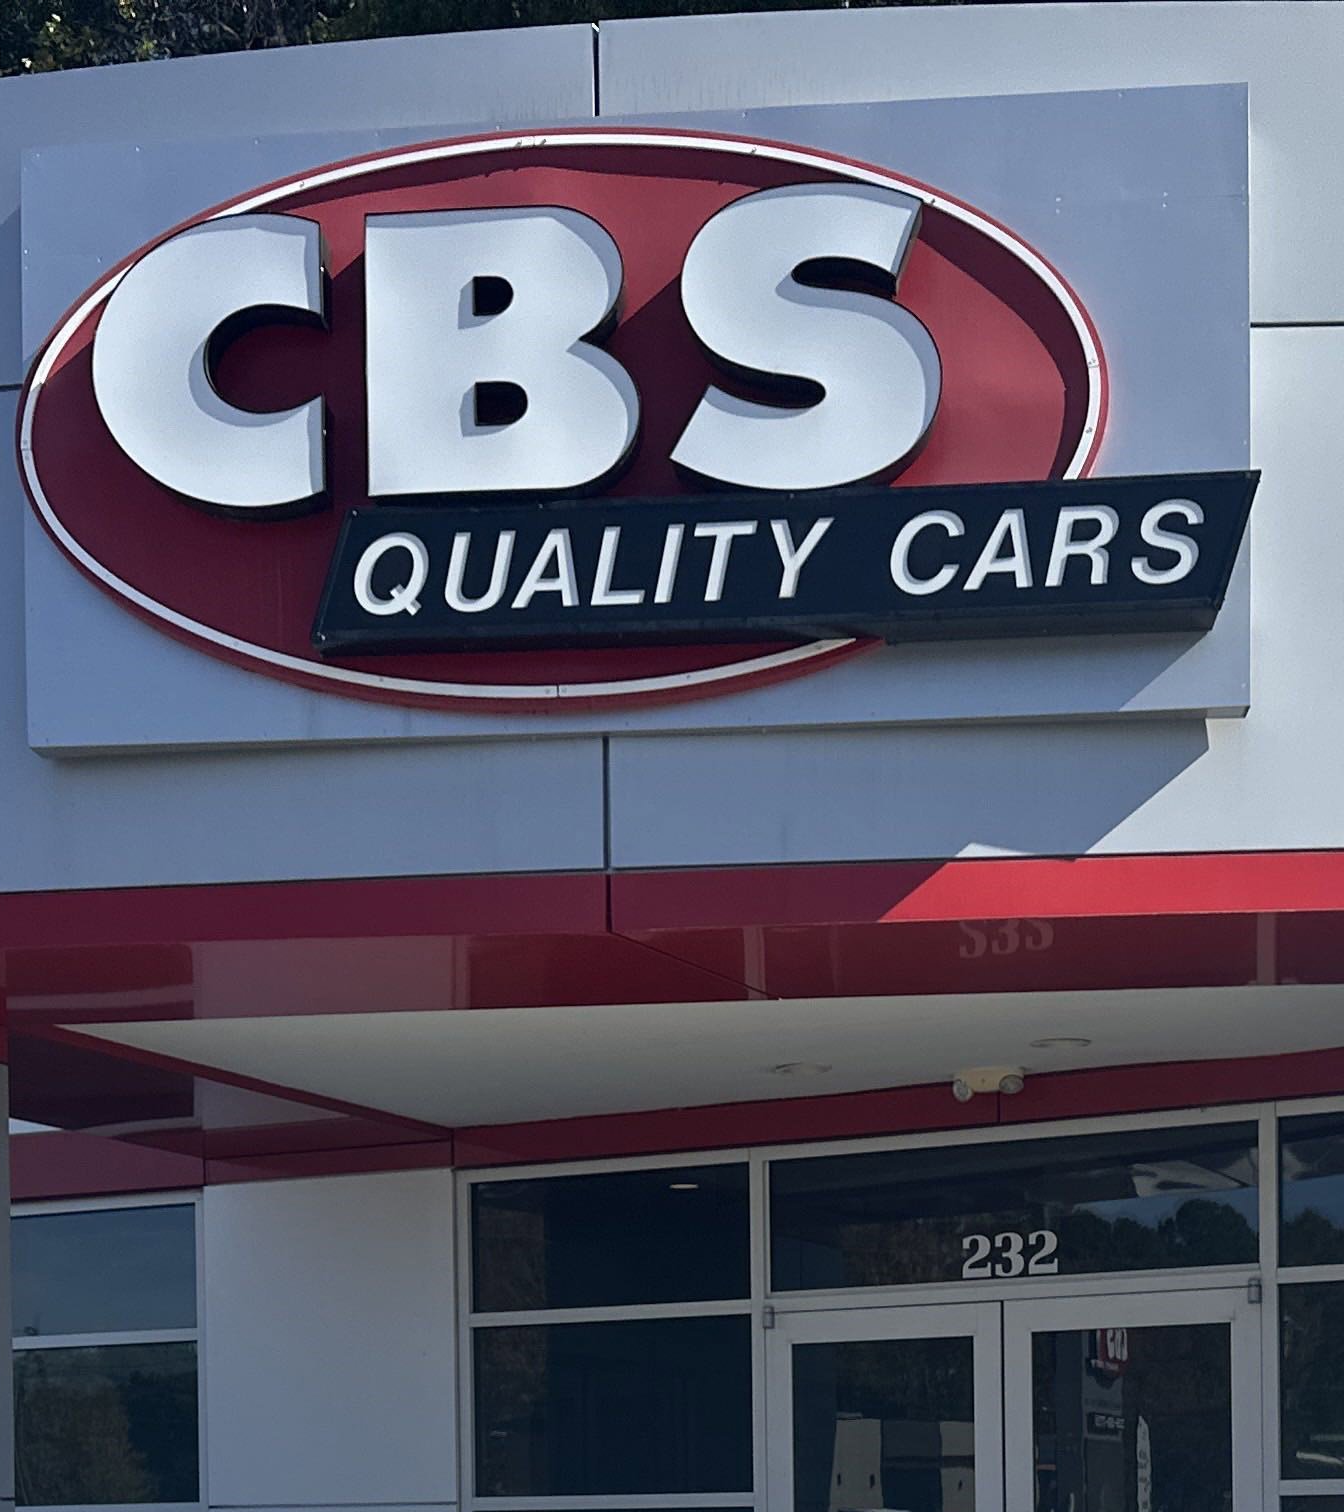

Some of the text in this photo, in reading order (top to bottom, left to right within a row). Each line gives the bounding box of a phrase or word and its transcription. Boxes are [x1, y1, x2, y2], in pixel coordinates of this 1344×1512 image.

[91, 181, 943, 514] CBS
[353, 497, 1206, 616] QUALITY CARS
[960, 1229, 1059, 1279] 232
